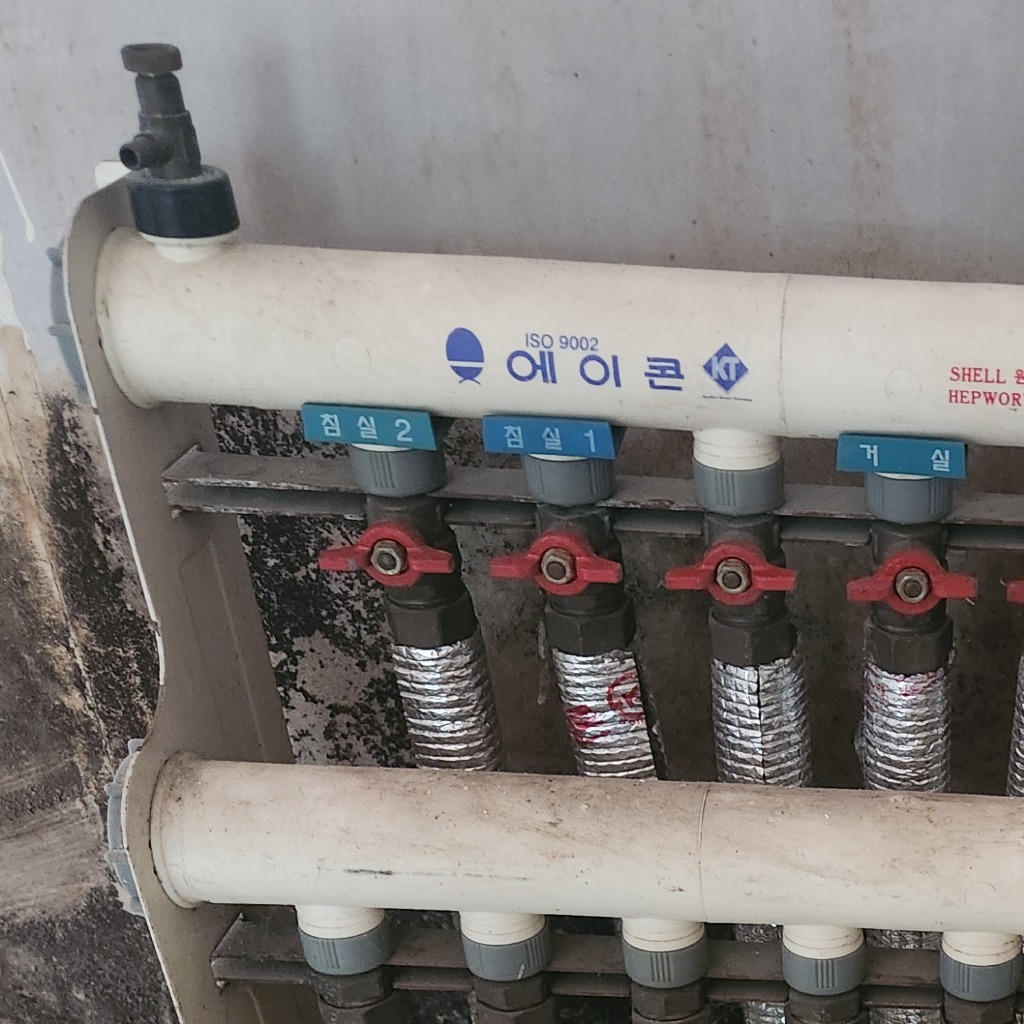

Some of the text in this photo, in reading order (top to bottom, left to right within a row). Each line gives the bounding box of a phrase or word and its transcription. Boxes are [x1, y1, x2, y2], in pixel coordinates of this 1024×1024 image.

[525, 333, 599, 351] ISO 9002
[949, 366, 1006, 384] SHELL
[394, 418, 413, 442] 2
[584, 429, 596, 452] 1
